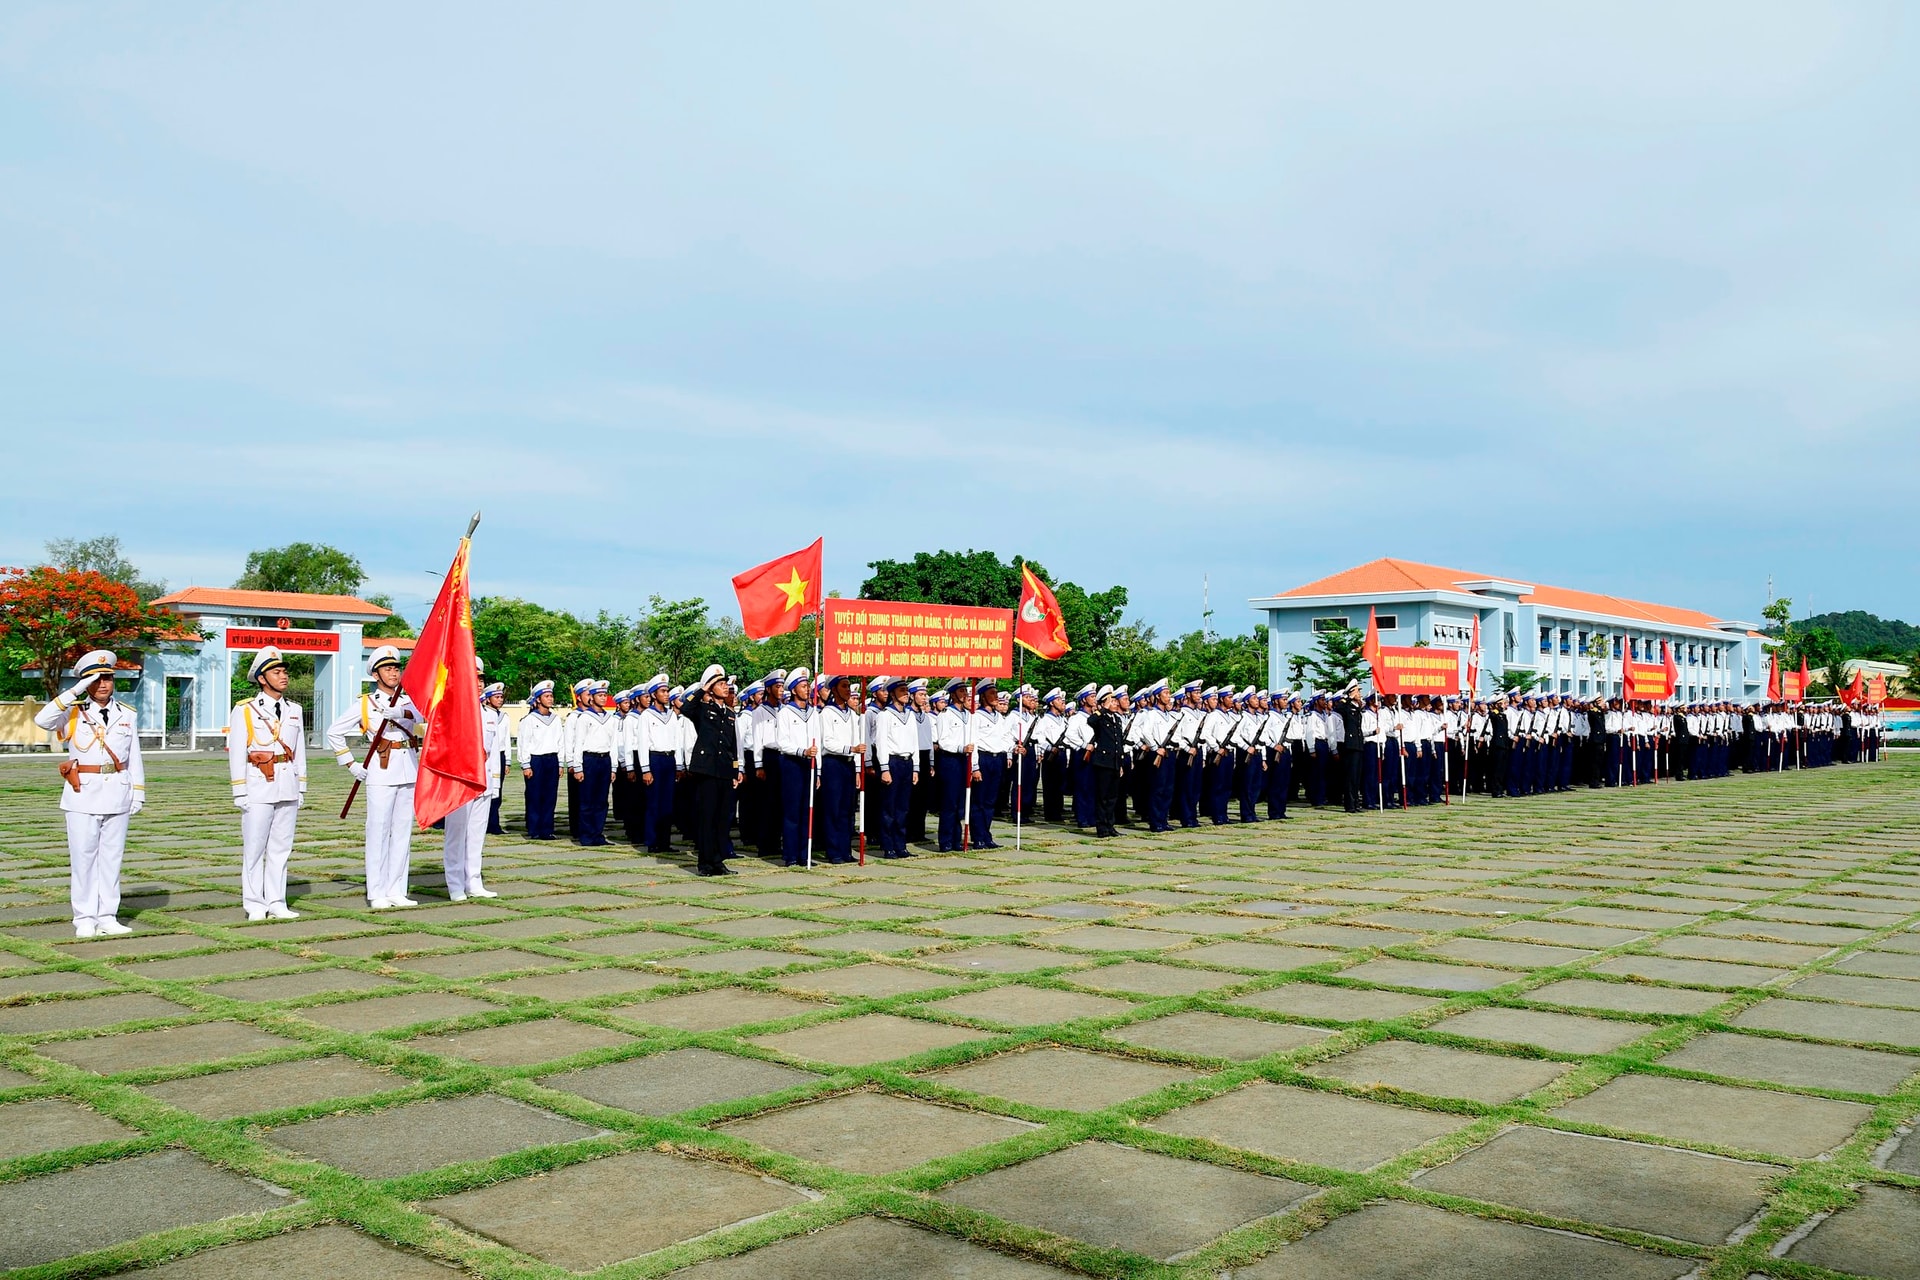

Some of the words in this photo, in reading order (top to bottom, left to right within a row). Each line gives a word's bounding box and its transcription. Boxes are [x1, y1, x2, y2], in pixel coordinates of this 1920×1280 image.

[834, 610, 854, 627] TUYỆT
[856, 609, 867, 625] ĐỐI
[868, 613, 890, 626] TRUNG
[892, 612, 912, 628] THÀNH
[913, 614, 924, 628] VỚI
[944, 613, 952, 629] TỔ
[953, 614, 968, 630] QUỐC
[970, 617, 977, 631] VÀ
[978, 618, 994, 631] NHÂN
[994, 618, 1006, 632] DÂN
[838, 630, 852, 644] CÁN
[854, 630, 865, 648] BỘ,
[866, 630, 886, 646] CHIẾN
[888, 632, 894, 646] SĨ
[896, 630, 910, 646] TIỂU
[910, 632, 928, 647] ĐOÀN
[954, 634, 970, 648] SÁNG
[988, 634, 1002, 650] CHẤT
[852, 650, 863, 667] ĐỘI
[864, 653, 874, 668] CỤ
[890, 651, 910, 666] NGƯỜI
[910, 651, 929, 666] CHIẾN
[930, 652, 936, 666] SĨ
